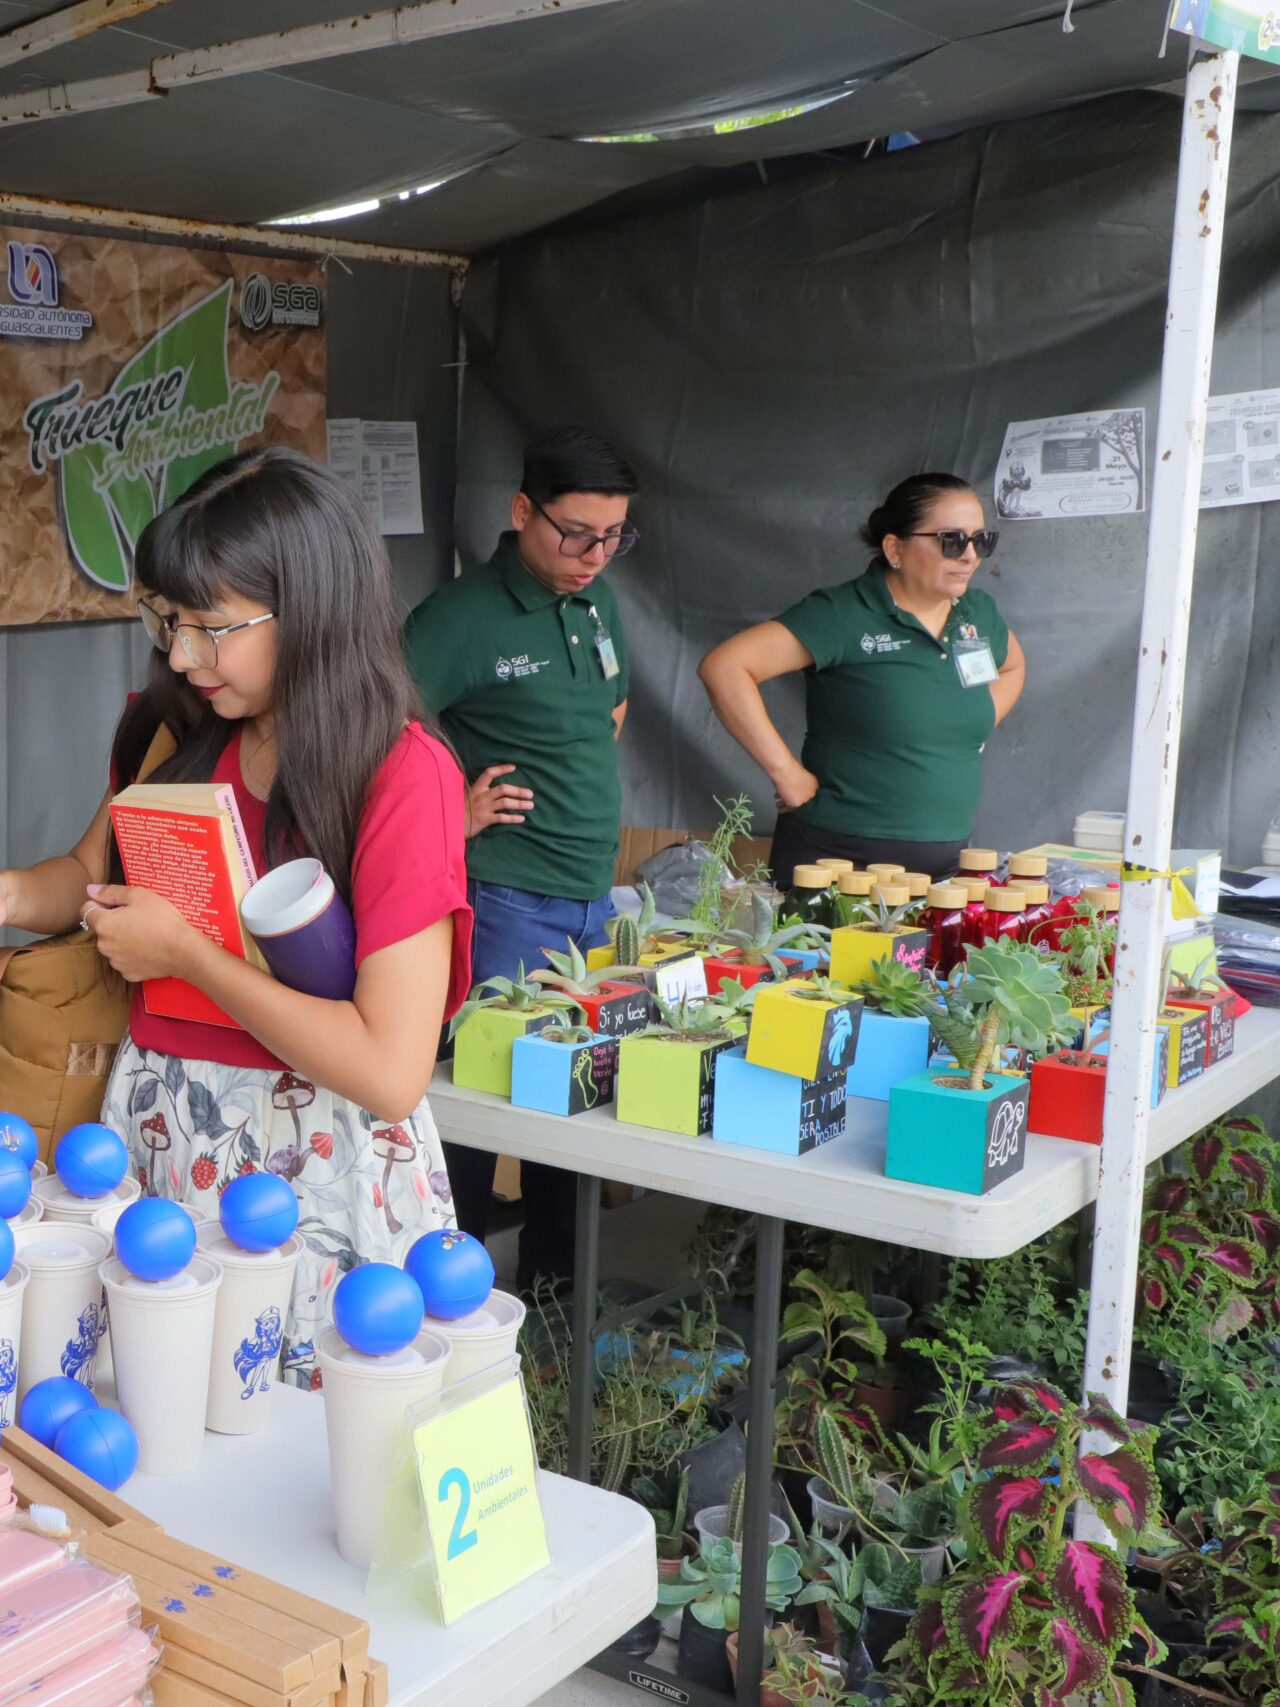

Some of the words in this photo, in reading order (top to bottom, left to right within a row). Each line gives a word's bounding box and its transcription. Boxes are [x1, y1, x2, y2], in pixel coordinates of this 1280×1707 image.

[26, 370, 183, 470] Trueque
[96, 375, 280, 486] Ambiental
[511, 654, 529, 666] SGI
[599, 1006, 611, 1029] Si
[615, 1013, 624, 1030] yo
[802, 1099, 815, 1118] TI
[820, 1095, 826, 1113] Y
[830, 1084, 847, 1110] TODO
[799, 1118, 821, 1141] SERA
[815, 1116, 847, 1145] POSIBLE
[438, 1467, 478, 1562] 2
[472, 1465, 514, 1495] Unidades
[478, 1485, 528, 1521] Ambientales
[636, 1675, 682, 1700] LIFETIME
